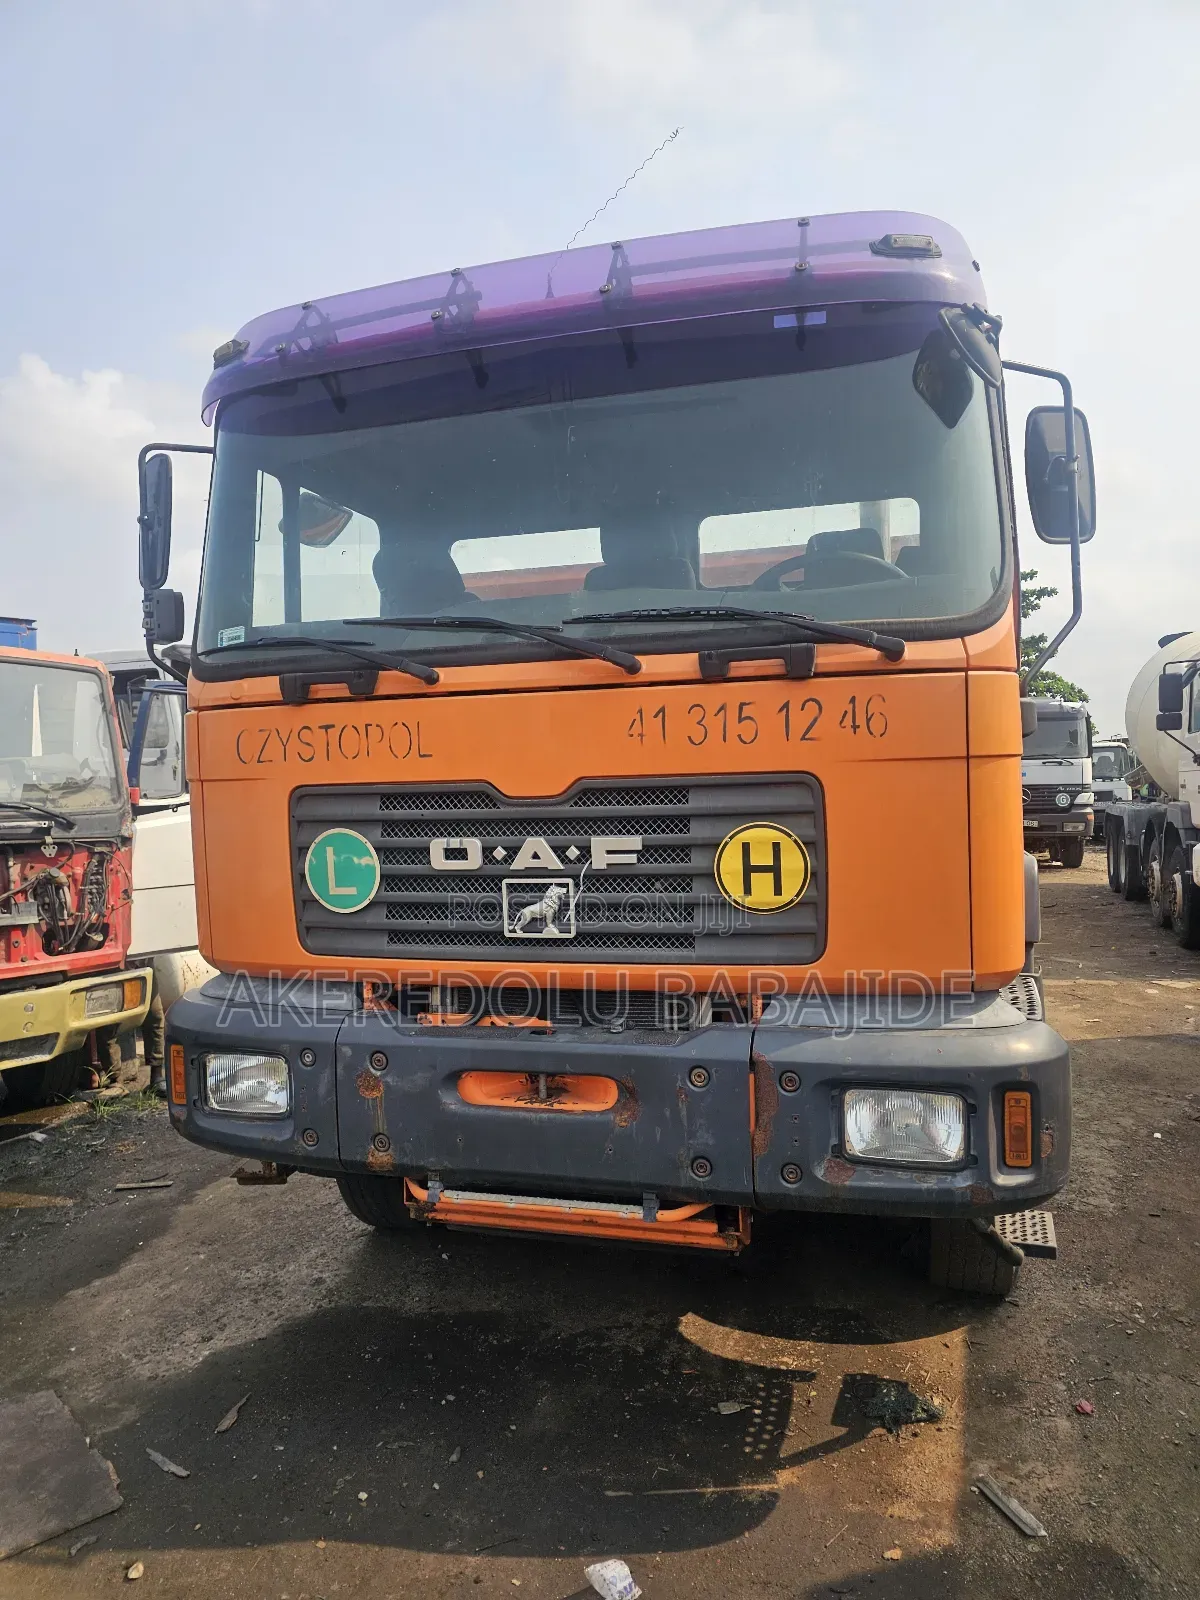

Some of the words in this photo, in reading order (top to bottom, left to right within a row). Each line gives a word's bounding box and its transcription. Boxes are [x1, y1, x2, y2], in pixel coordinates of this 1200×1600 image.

[236, 720, 433, 765] CZYSTOPOL
[627, 705, 667, 747] 41
[686, 701, 760, 747] 315
[776, 696, 824, 742] 12
[838, 693, 889, 739] 46
[325, 846, 358, 896] L
[741, 841, 784, 897] H
